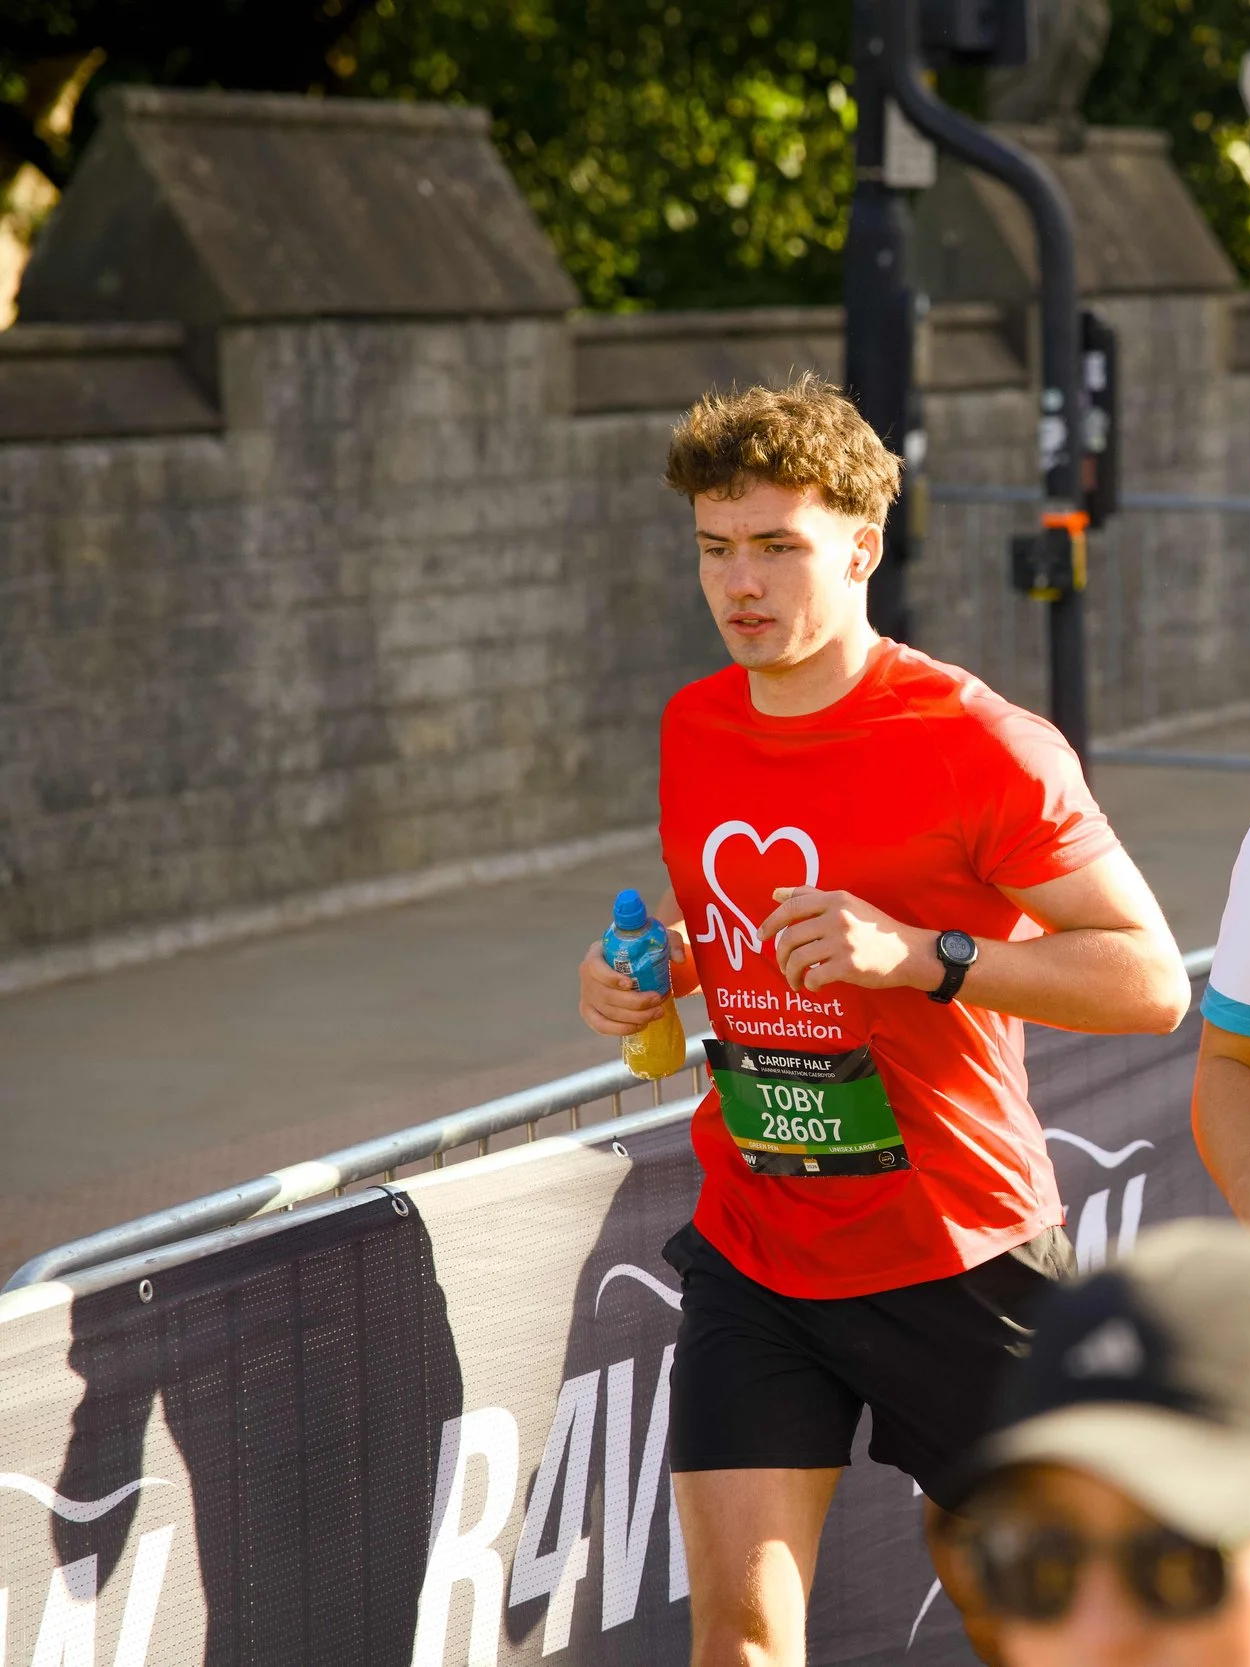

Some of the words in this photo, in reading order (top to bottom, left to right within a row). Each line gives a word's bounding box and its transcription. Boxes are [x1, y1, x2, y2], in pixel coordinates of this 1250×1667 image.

[717, 987, 780, 1011] British
[786, 991, 844, 1017] Heart
[725, 1014, 842, 1039] Foundation
[758, 1054, 802, 1068] CARDIFF
[804, 1059, 832, 1071] HALF
[757, 1083, 825, 1114] TOBY
[761, 1112, 842, 1142] 28607
[829, 1145, 853, 1153] UNISEX
[854, 1143, 878, 1152] LARGE
